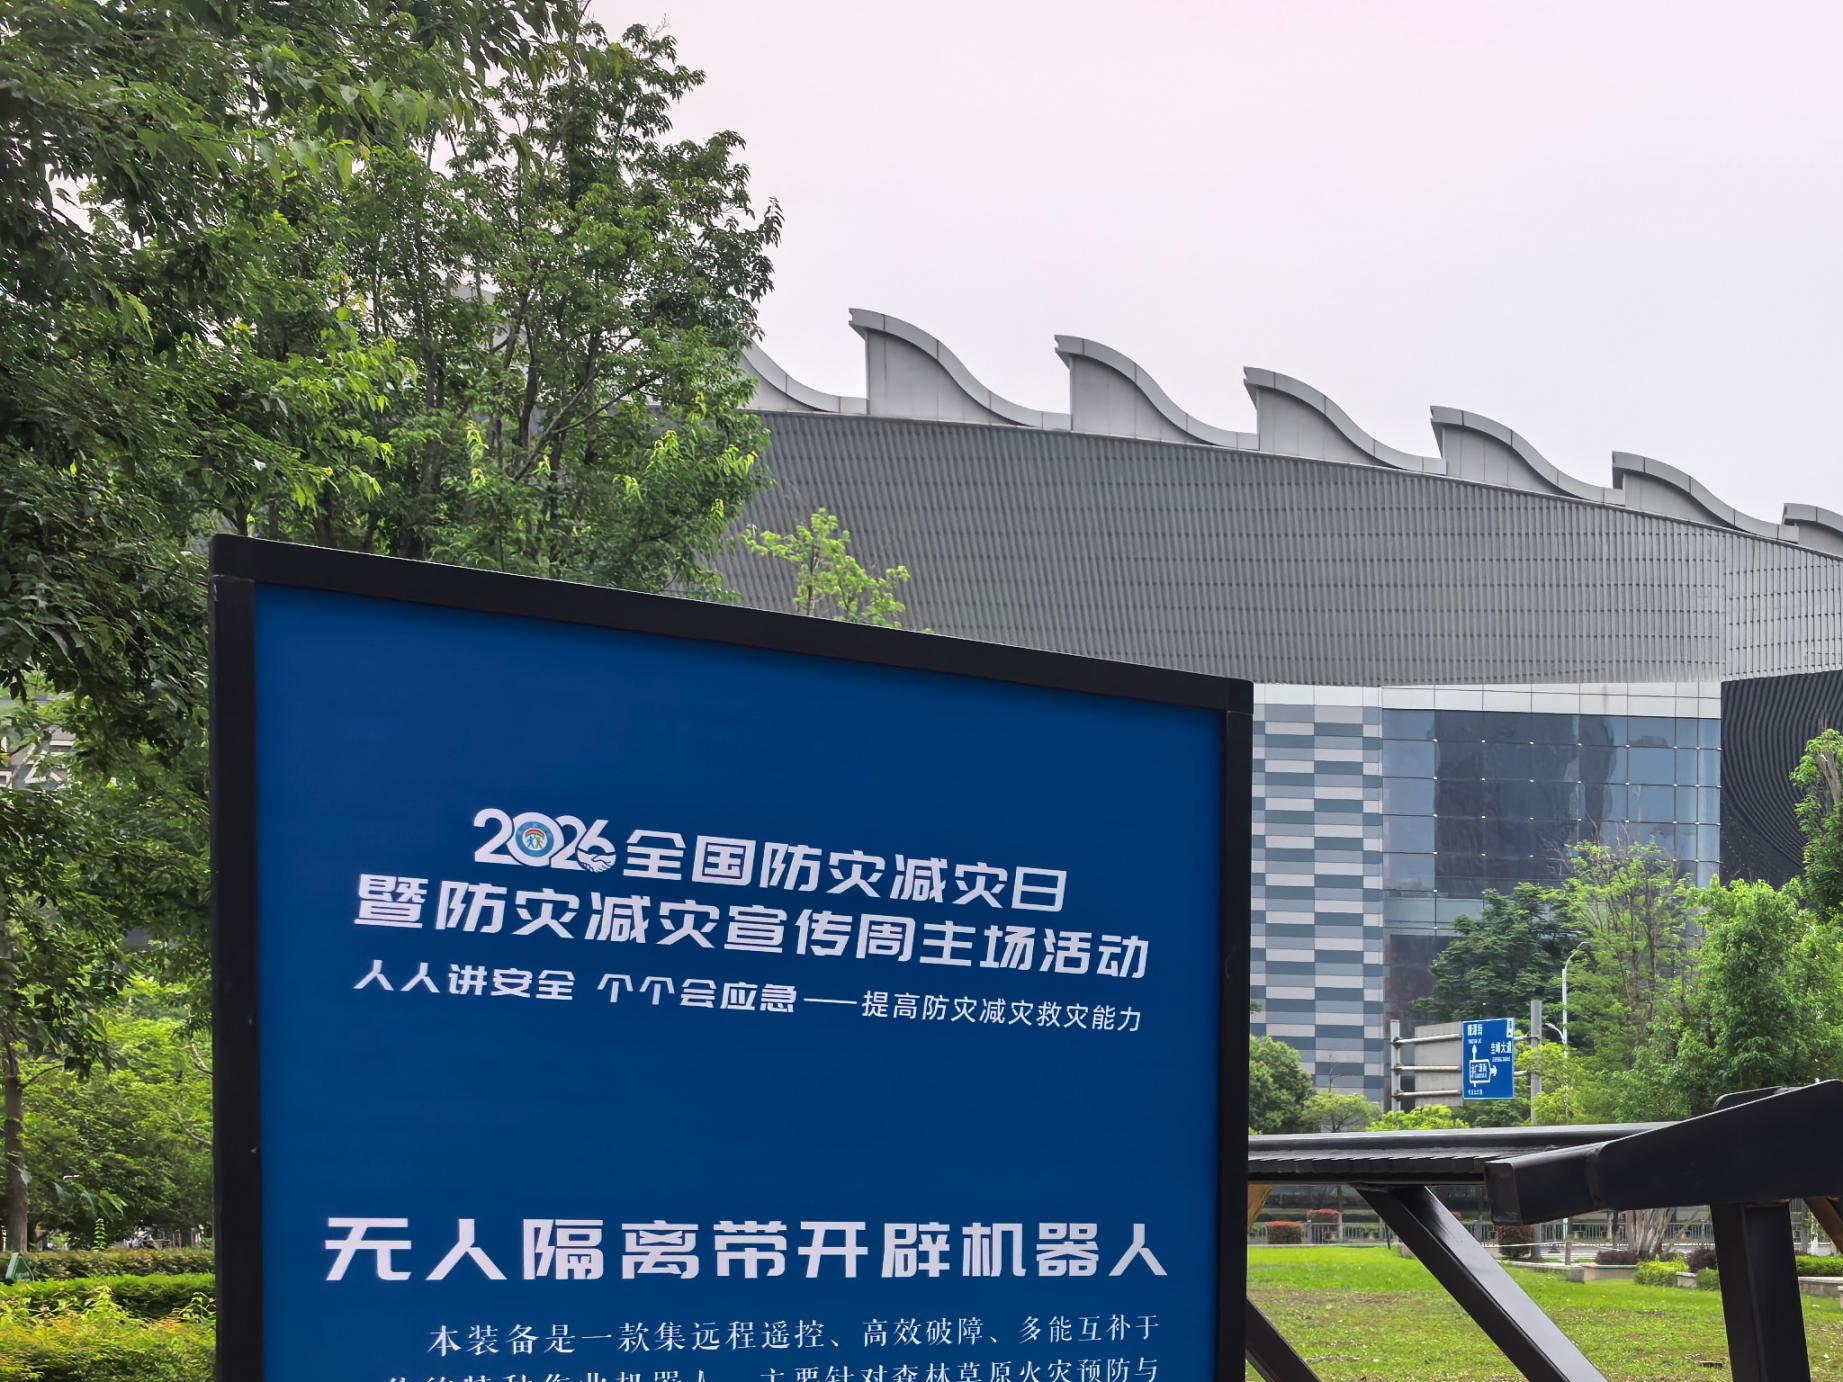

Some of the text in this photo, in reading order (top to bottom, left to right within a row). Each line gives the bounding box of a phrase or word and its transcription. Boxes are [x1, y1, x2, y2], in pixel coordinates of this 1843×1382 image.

[354, 873, 1150, 980] 暨防灾减灾宣传周主场活动
[353, 959, 576, 1001] 人人讲安全
[324, 1217, 1169, 1282] 无人隔离带开辟机器人
